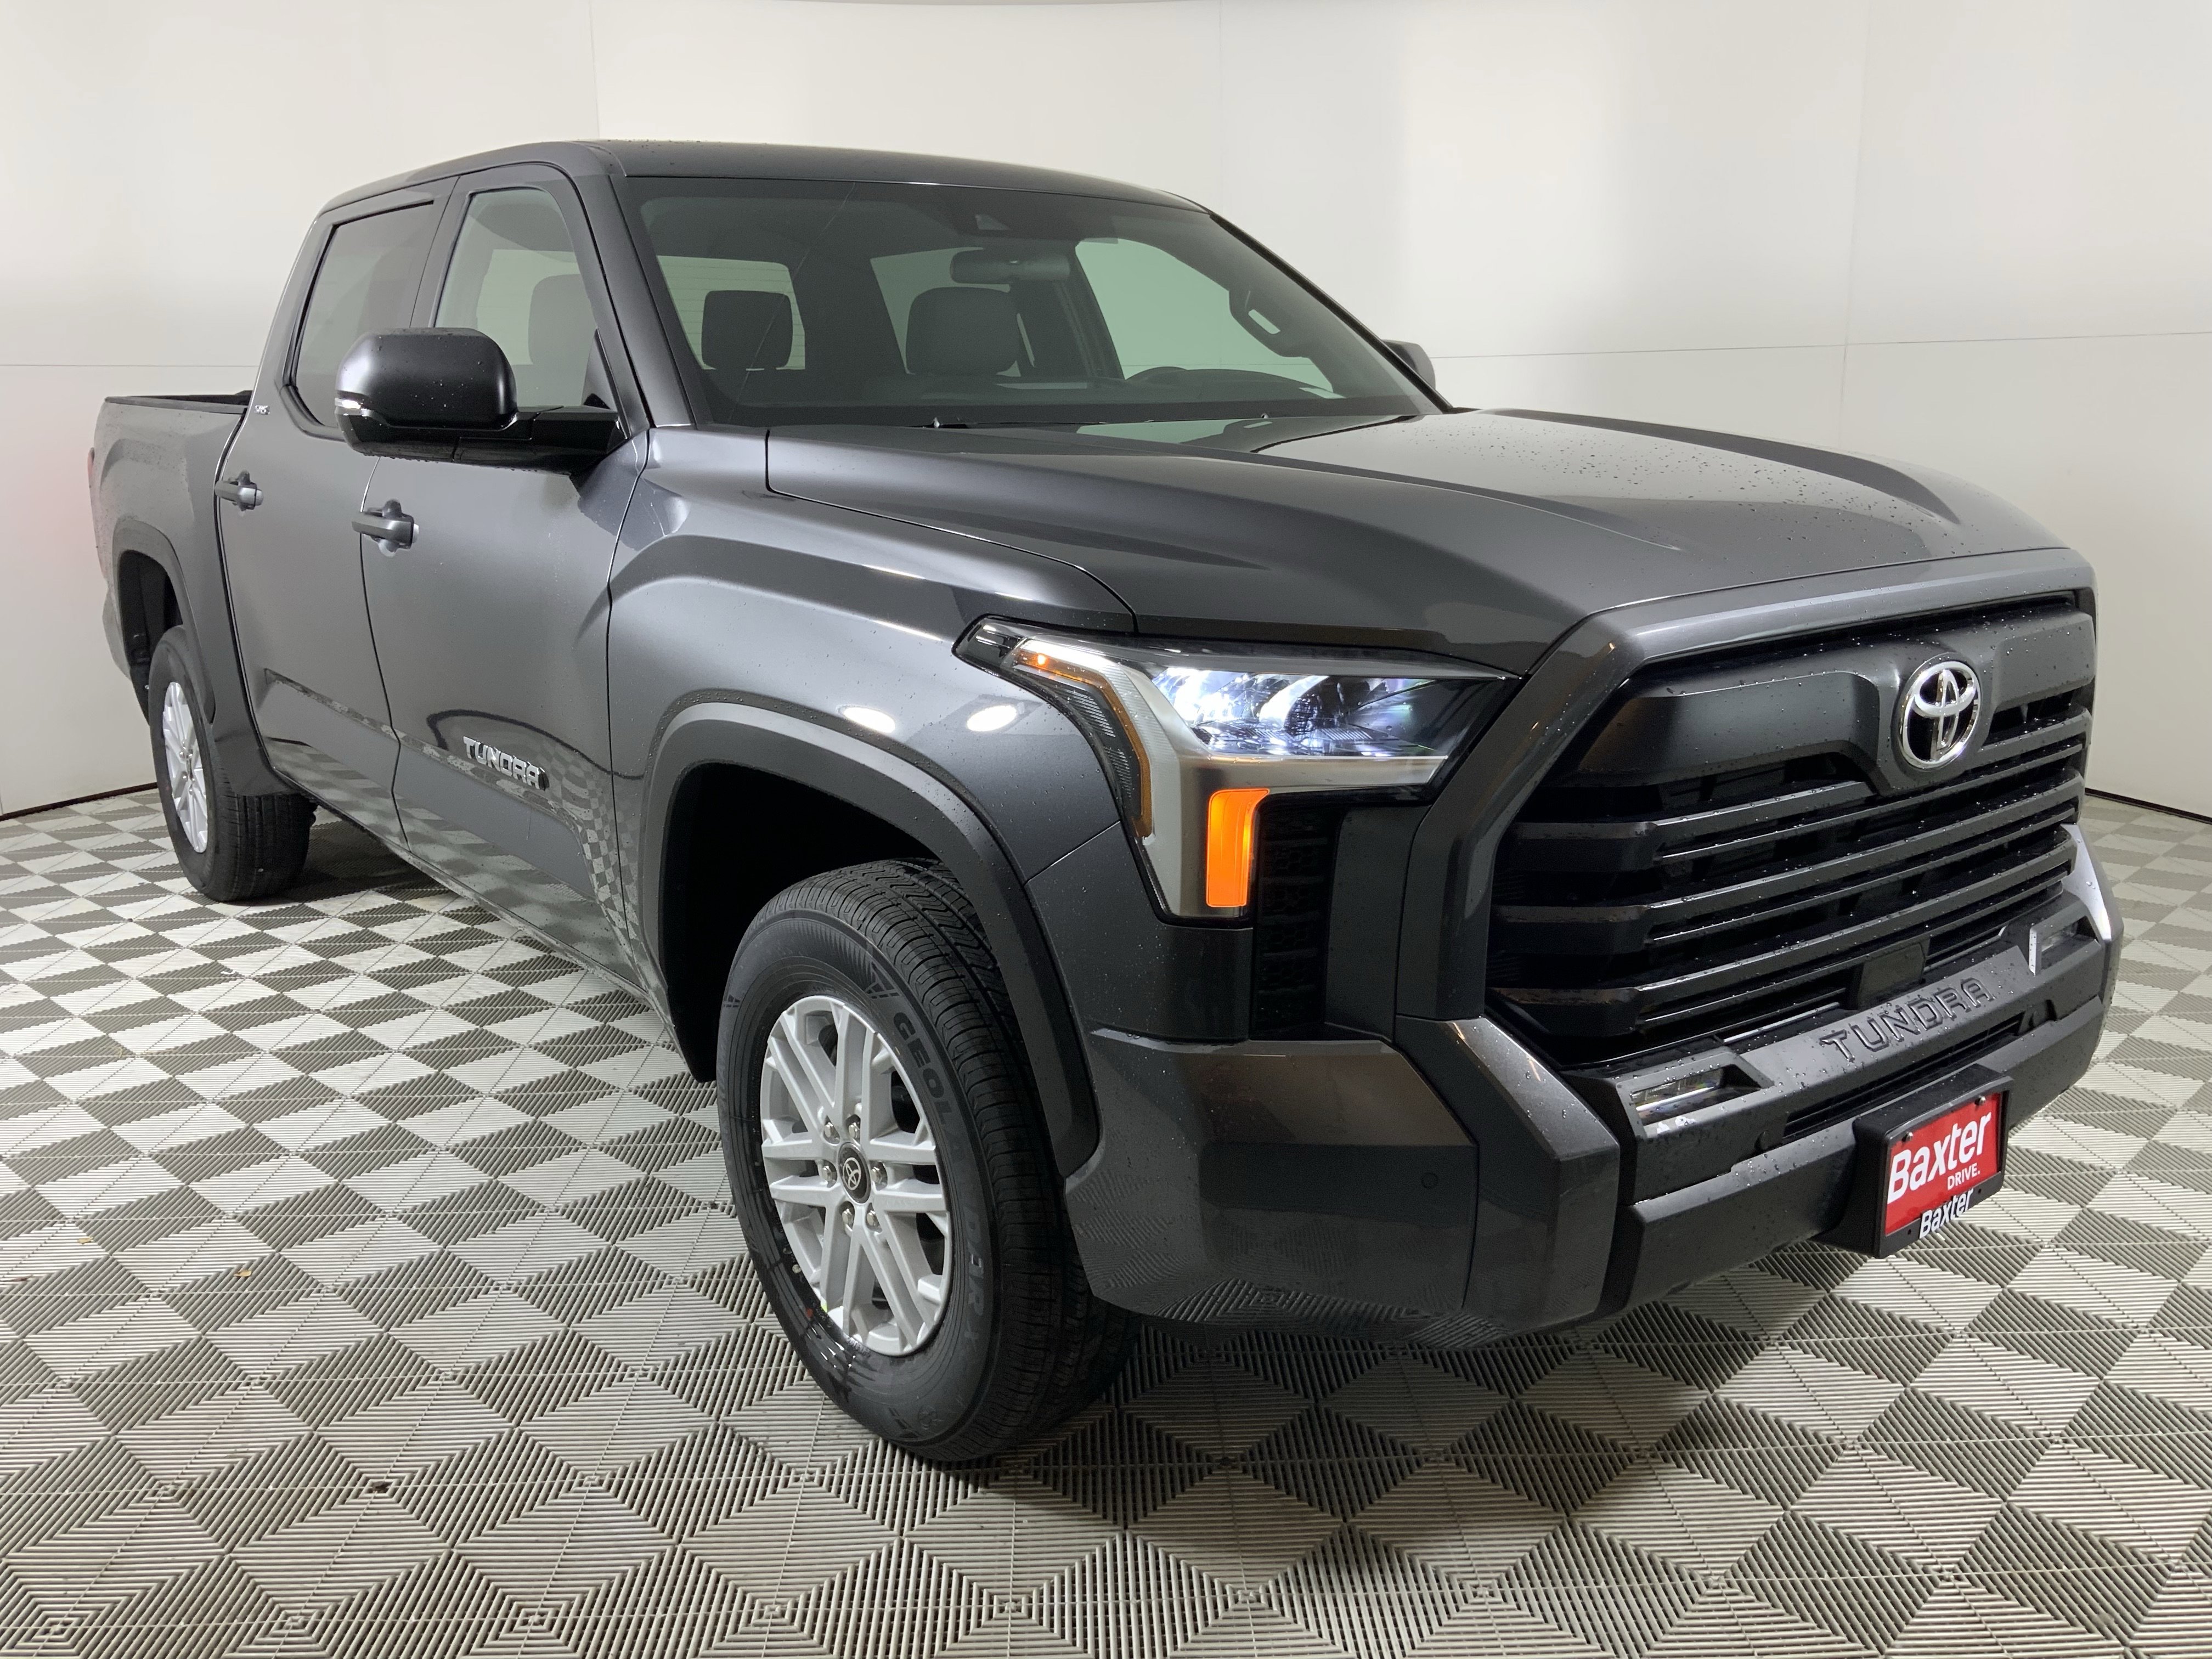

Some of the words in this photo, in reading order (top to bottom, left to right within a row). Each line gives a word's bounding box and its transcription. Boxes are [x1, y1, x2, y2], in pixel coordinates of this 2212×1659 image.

[463, 736, 545, 790] TUNDRA
[1819, 976, 1997, 1063] TUNDRA
[1887, 1111, 1992, 1204] Baxter
[1947, 1163, 1980, 1190] DRIVE.
[1920, 1189, 1974, 1239] Baxter
